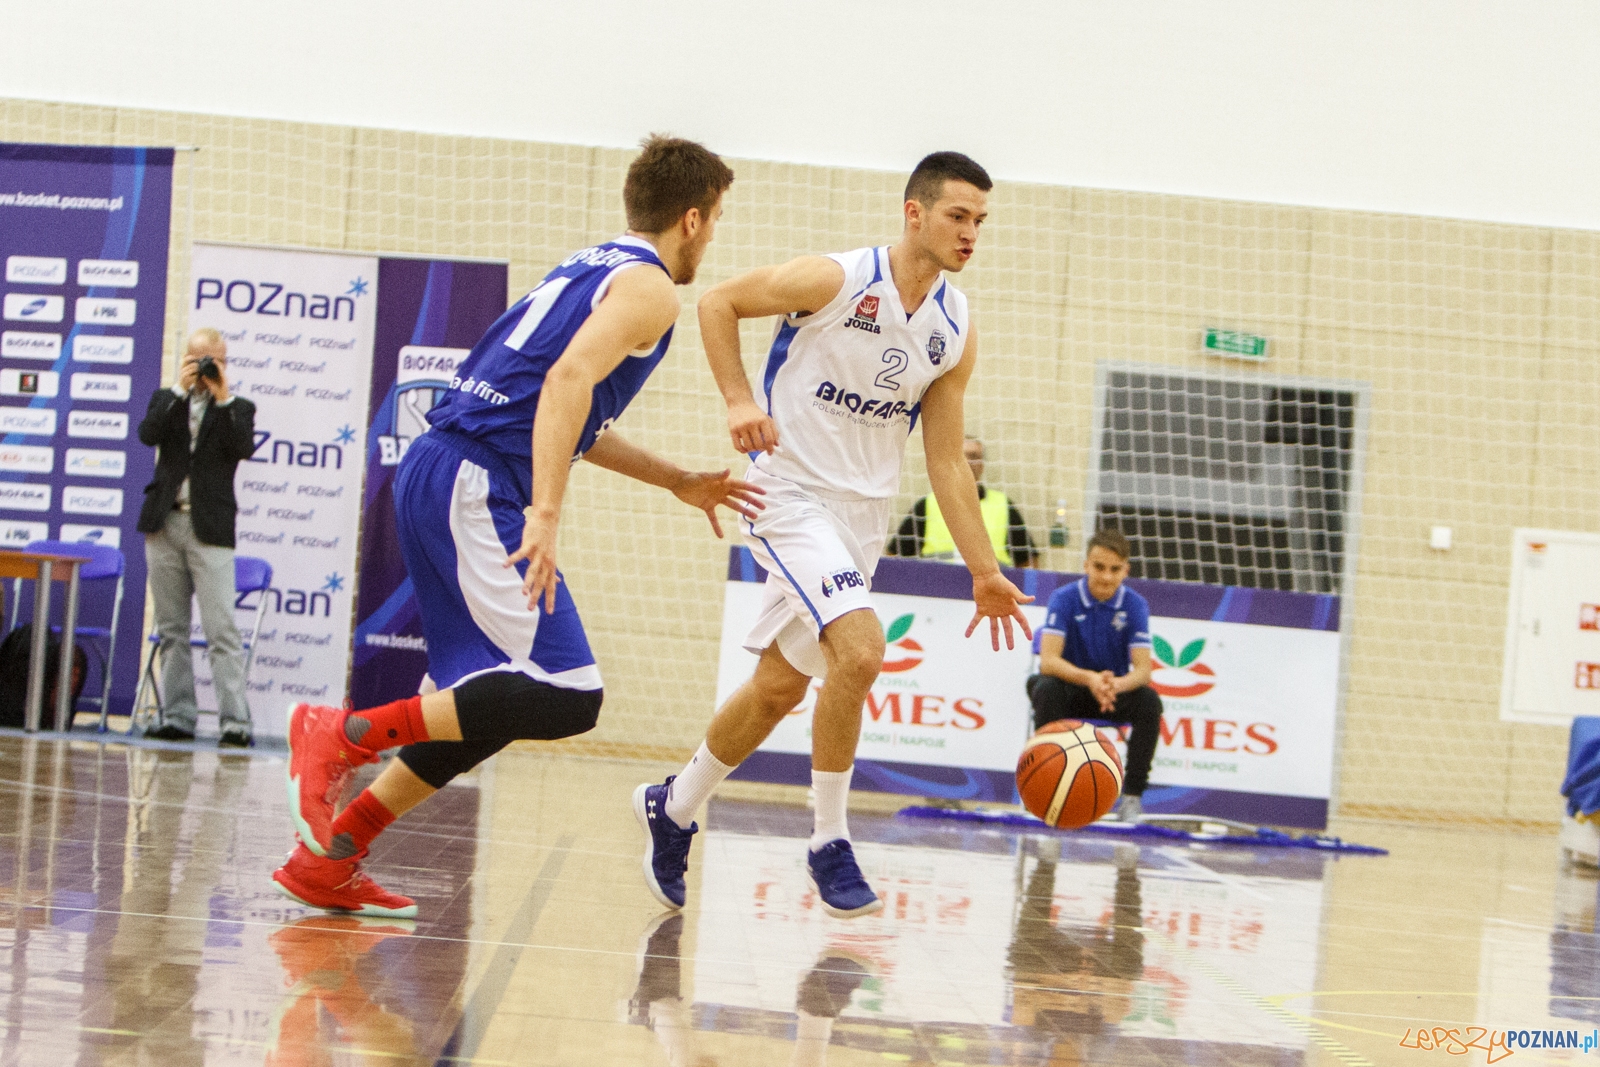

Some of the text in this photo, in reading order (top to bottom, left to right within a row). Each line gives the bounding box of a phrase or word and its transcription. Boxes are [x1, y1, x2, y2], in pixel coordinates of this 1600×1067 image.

[504, 276, 572, 351] 1
[403, 354, 460, 372] BIOFAR
[874, 348, 908, 391] 2
[812, 400, 845, 418] POLSKI
[250, 431, 342, 469] Znan
[832, 570, 865, 591] PBG
[234, 586, 331, 617] Znan
[787, 686, 986, 732] MES
[1116, 714, 1278, 756] MES
